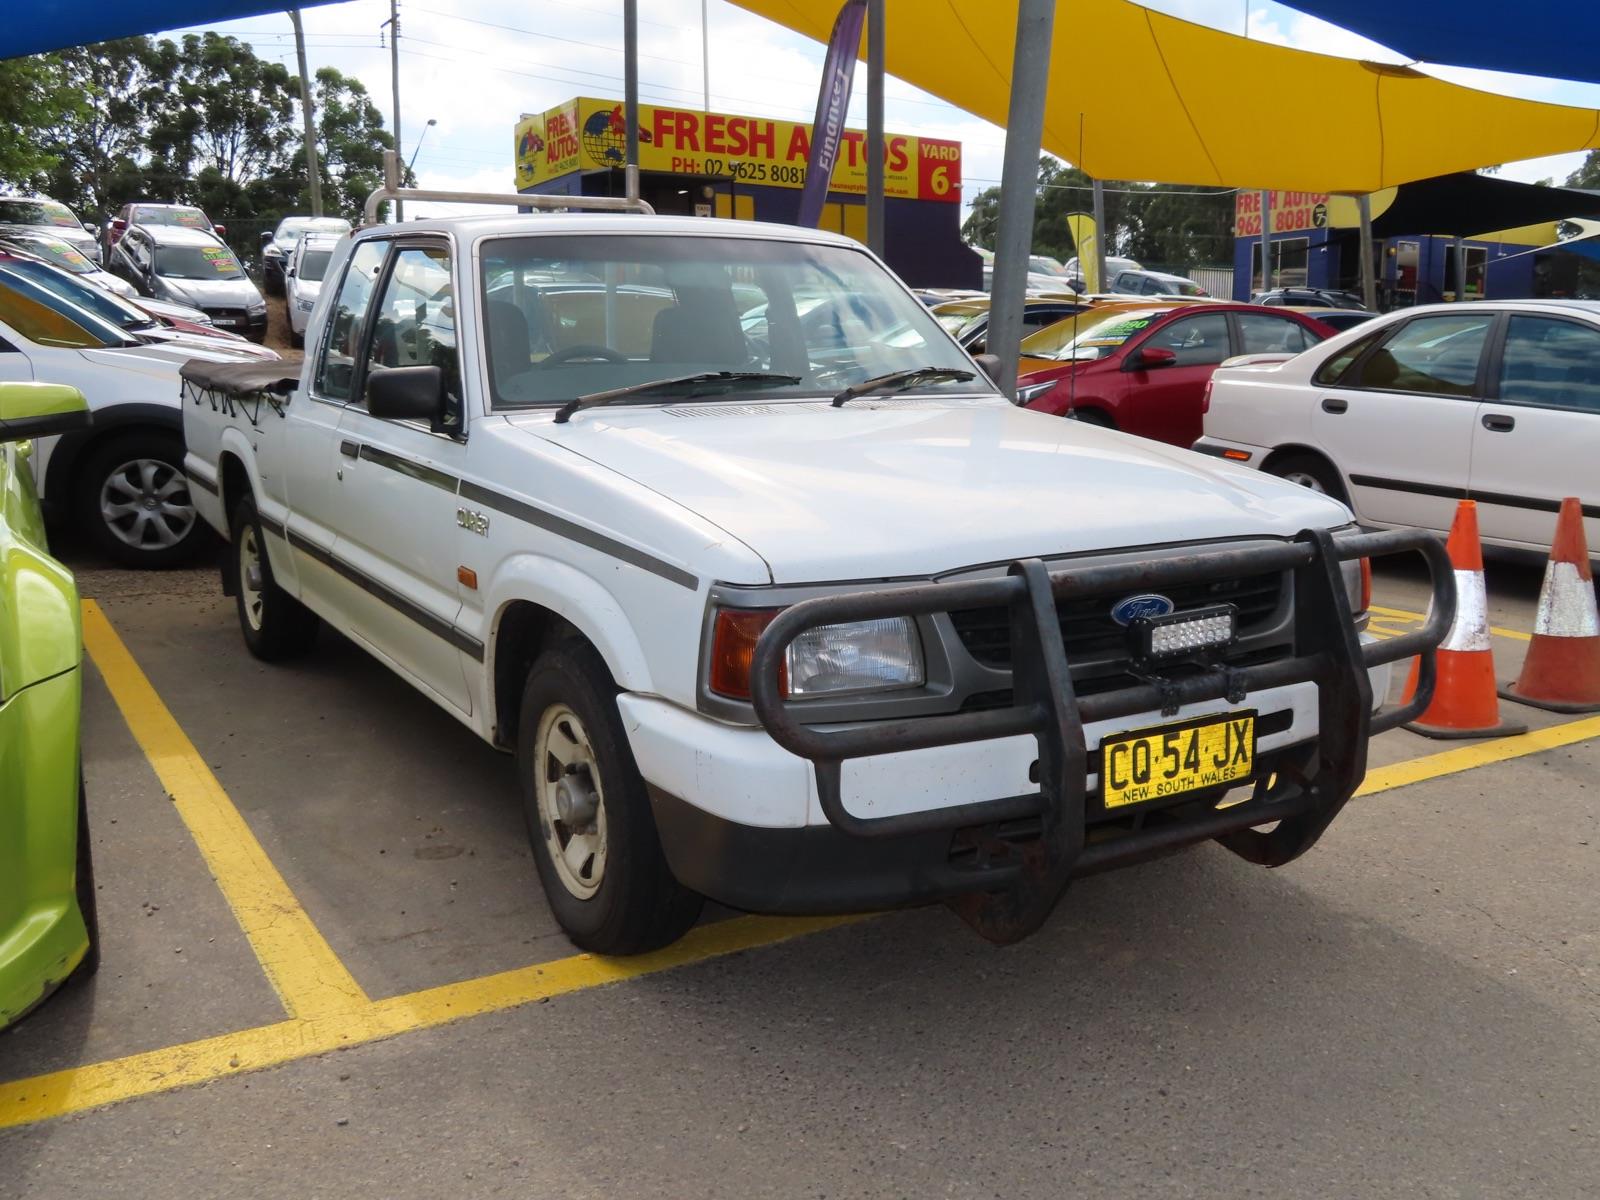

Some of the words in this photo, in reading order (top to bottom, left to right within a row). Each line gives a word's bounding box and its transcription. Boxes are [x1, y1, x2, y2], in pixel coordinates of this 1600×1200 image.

[653, 109, 775, 160] FRESH
[786, 126, 909, 173] ATS
[818, 80, 842, 172] Finance
[546, 134, 579, 165] AUTOS
[921, 143, 960, 161] YARD
[671, 156, 701, 174] PH:
[704, 158, 723, 176] 02
[727, 162, 766, 181] 9625
[770, 165, 805, 184] 8081
[930, 166, 949, 196] 6
[1236, 190, 1278, 214] FREH
[1236, 214, 1263, 237] 962
[1275, 207, 1312, 232] 8081
[1127, 599, 1161, 619] Ford
[1123, 788, 1150, 803] NEW
[1156, 777, 1195, 796] SOUTH
[1200, 766, 1237, 786] WALES
